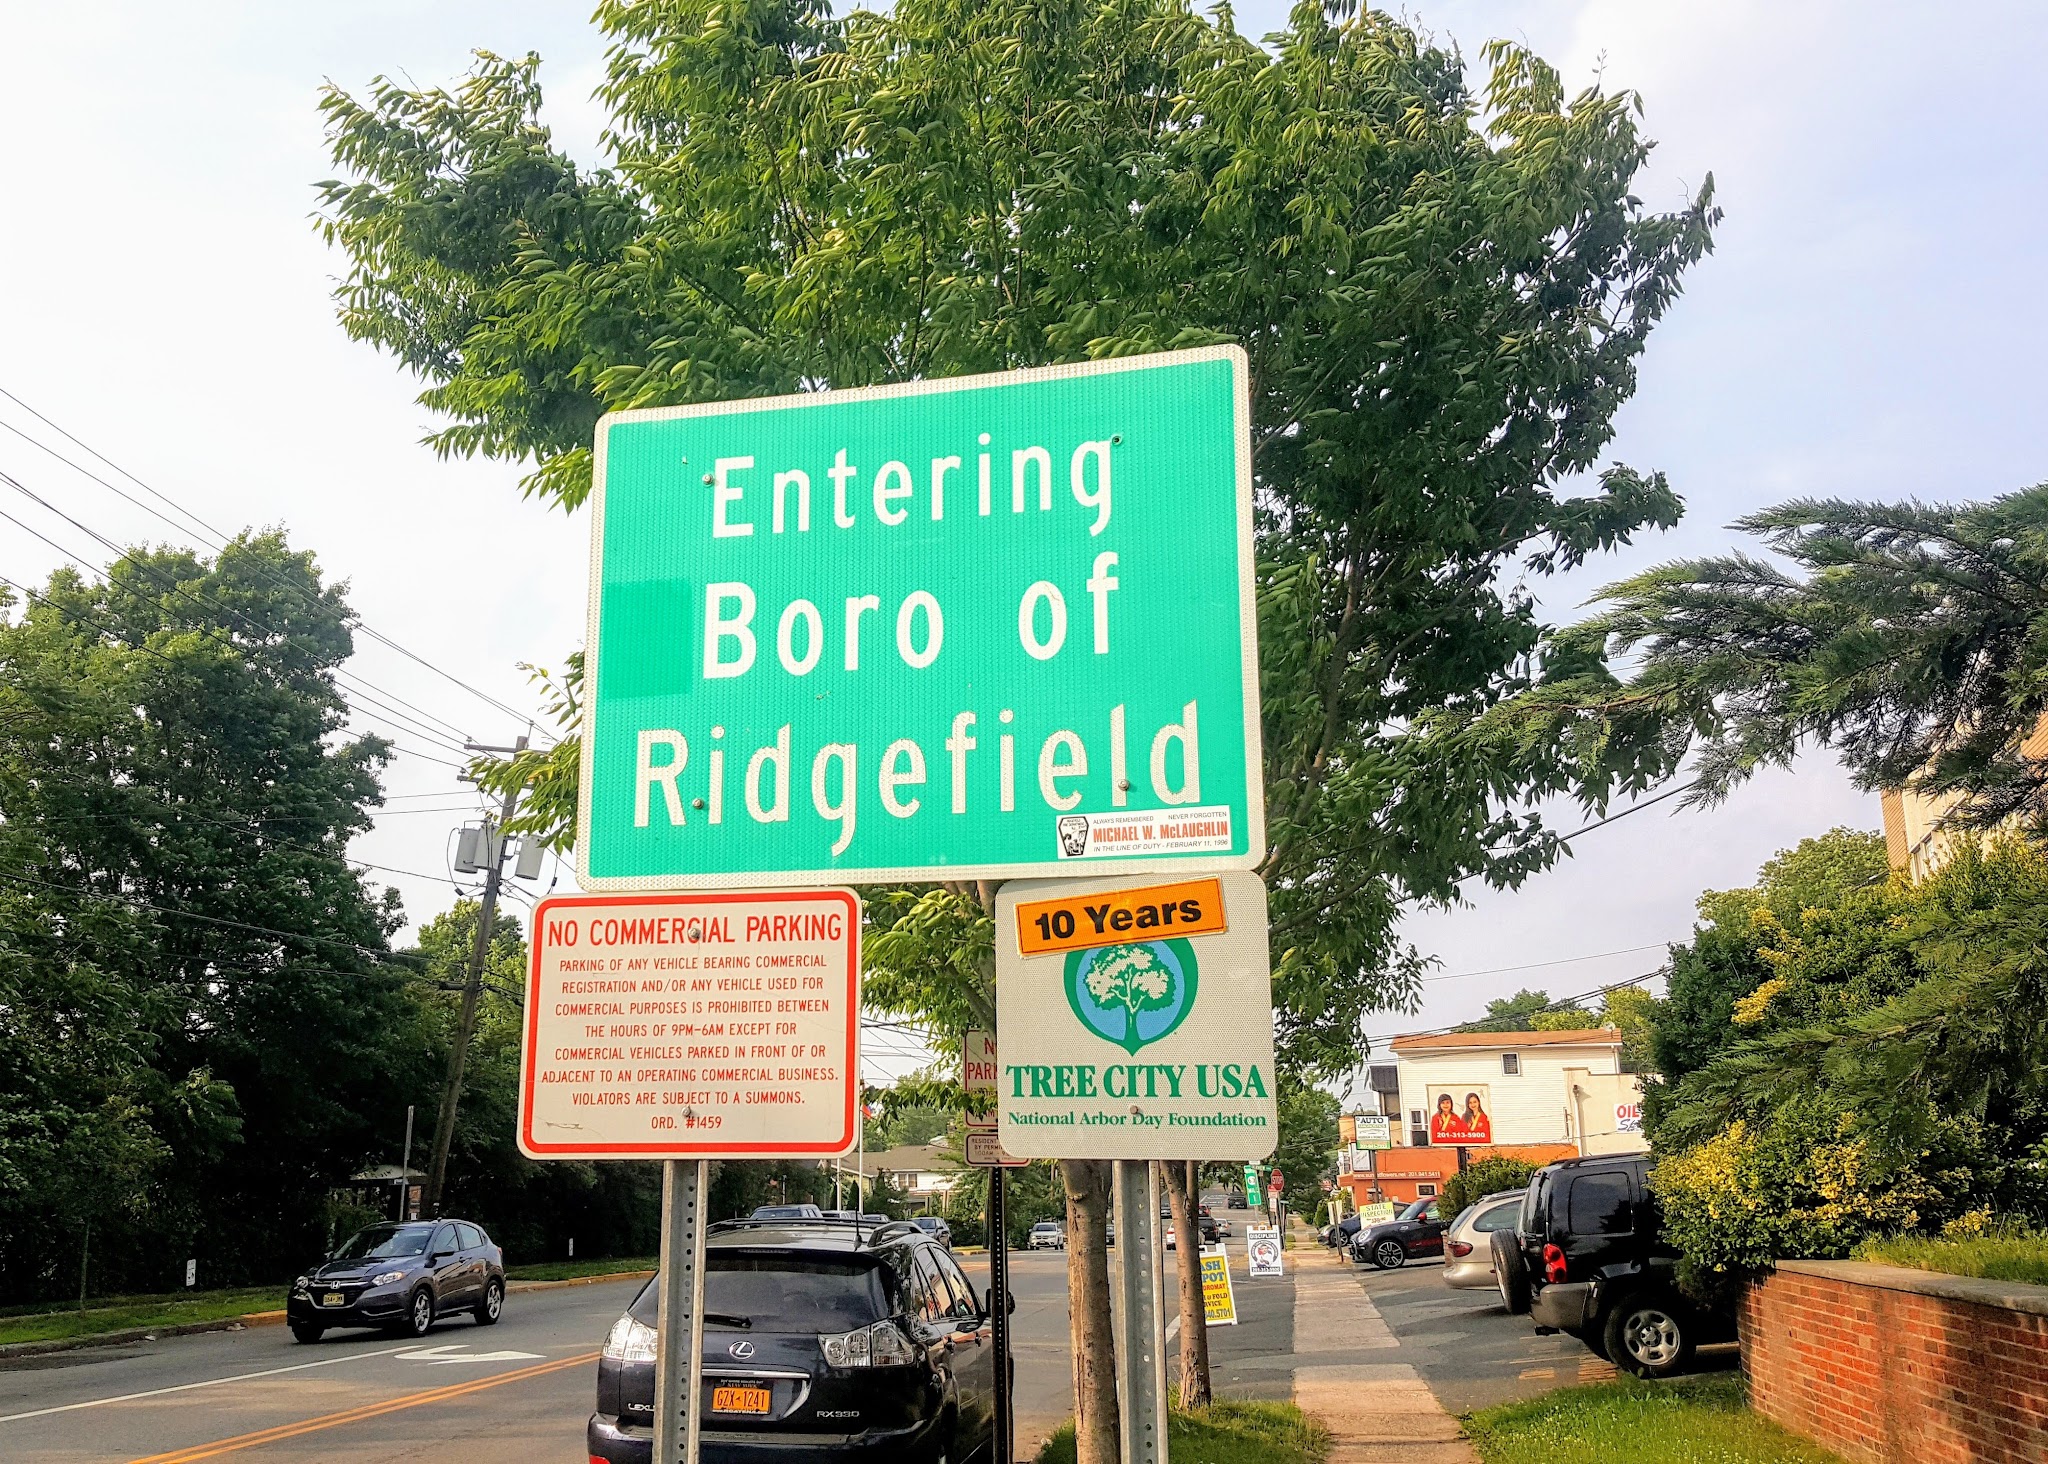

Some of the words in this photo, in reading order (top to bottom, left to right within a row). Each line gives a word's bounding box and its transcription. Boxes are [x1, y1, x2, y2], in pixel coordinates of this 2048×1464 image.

[712, 433, 1113, 537] Entering
[703, 581, 944, 680] Boro
[1018, 552, 1119, 662] of
[633, 700, 1201, 857] Ridgefield
[1093, 817, 1115, 825] ALWAYS
[1115, 815, 1154, 823] REMEMBERED
[1190, 811, 1227, 819] FORGOTTEN
[1093, 826, 1139, 843] MICHAEL
[1142, 825, 1156, 840] W.
[1160, 821, 1228, 840] McLAUGHLIN
[1165, 841, 1202, 849] FEBRUARY
[1035, 909, 1075, 940] 10
[1084, 899, 1202, 934] Years
[548, 920, 578, 947] NO
[590, 916, 735, 946] COMMERCIAL
[746, 913, 841, 942] PARKING
[560, 959, 604, 972] PARKING
[609, 959, 623, 971] OF
[628, 958, 648, 970] ANY
[653, 957, 698, 970] VEHICLE
[704, 956, 750, 969] BEARING
[756, 955, 827, 968] COMMERCIAL
[562, 981, 636, 993] REGISTRATION
[641, 979, 686, 993] AND/OR
[691, 979, 712, 992] ANY
[717, 978, 762, 991] VEHICLE
[768, 978, 797, 990] USED
[802, 978, 823, 989] FOR
[555, 1003, 624, 1016] COMMERCIAL
[630, 1002, 687, 1015] PURPOSES
[692, 1002, 702, 1013] IS
[708, 1000, 772, 1013] PROHIBITED
[778, 999, 829, 1012] BETWEEN
[585, 1025, 605, 1038] THE
[610, 1025, 647, 1037] HOURS
[652, 1024, 666, 1036] OF
[672, 1024, 724, 1036] 9PM-6AM
[729, 1023, 771, 1035] EXCEPT
[776, 1022, 796, 1034] FOR
[555, 1048, 624, 1061] COMMERCIAL
[630, 1047, 682, 1060] VEHICLES
[688, 1046, 729, 1059] PARKED
[735, 1046, 746, 1058] IN
[751, 1045, 786, 1058] FRONT
[791, 1045, 805, 1057] OF
[811, 1045, 826, 1057] OR
[542, 1070, 595, 1083] ADJACENT
[600, 1070, 612, 1082] TO
[618, 1070, 632, 1082] AN
[638, 1069, 696, 1082] OPERATING
[701, 1068, 773, 1081] COMMERCIAL
[778, 1068, 839, 1081] BUSINESS.
[1006, 1064, 1097, 1098] TREE
[1103, 1063, 1187, 1098] CITY
[1195, 1064, 1268, 1098] USA
[572, 1092, 630, 1105] VIOLATORS
[635, 1092, 656, 1104] ARE
[663, 1092, 711, 1105] SUBJECT
[715, 1092, 728, 1104] TO
[733, 1092, 740, 1103] A
[745, 1091, 805, 1103] SUMMONS.
[651, 1117, 678, 1129] ORD.
[686, 1116, 722, 1129] #1459
[1008, 1112, 1074, 1126] National
[1080, 1112, 1126, 1126] Arbor
[1132, 1112, 1162, 1129] Day
[1169, 1112, 1267, 1126] Foundation
[1272, 1176, 1283, 1184] STOP
[1361, 1209, 1393, 1217] INSPECTION
[628, 1403, 656, 1411] LEXU
